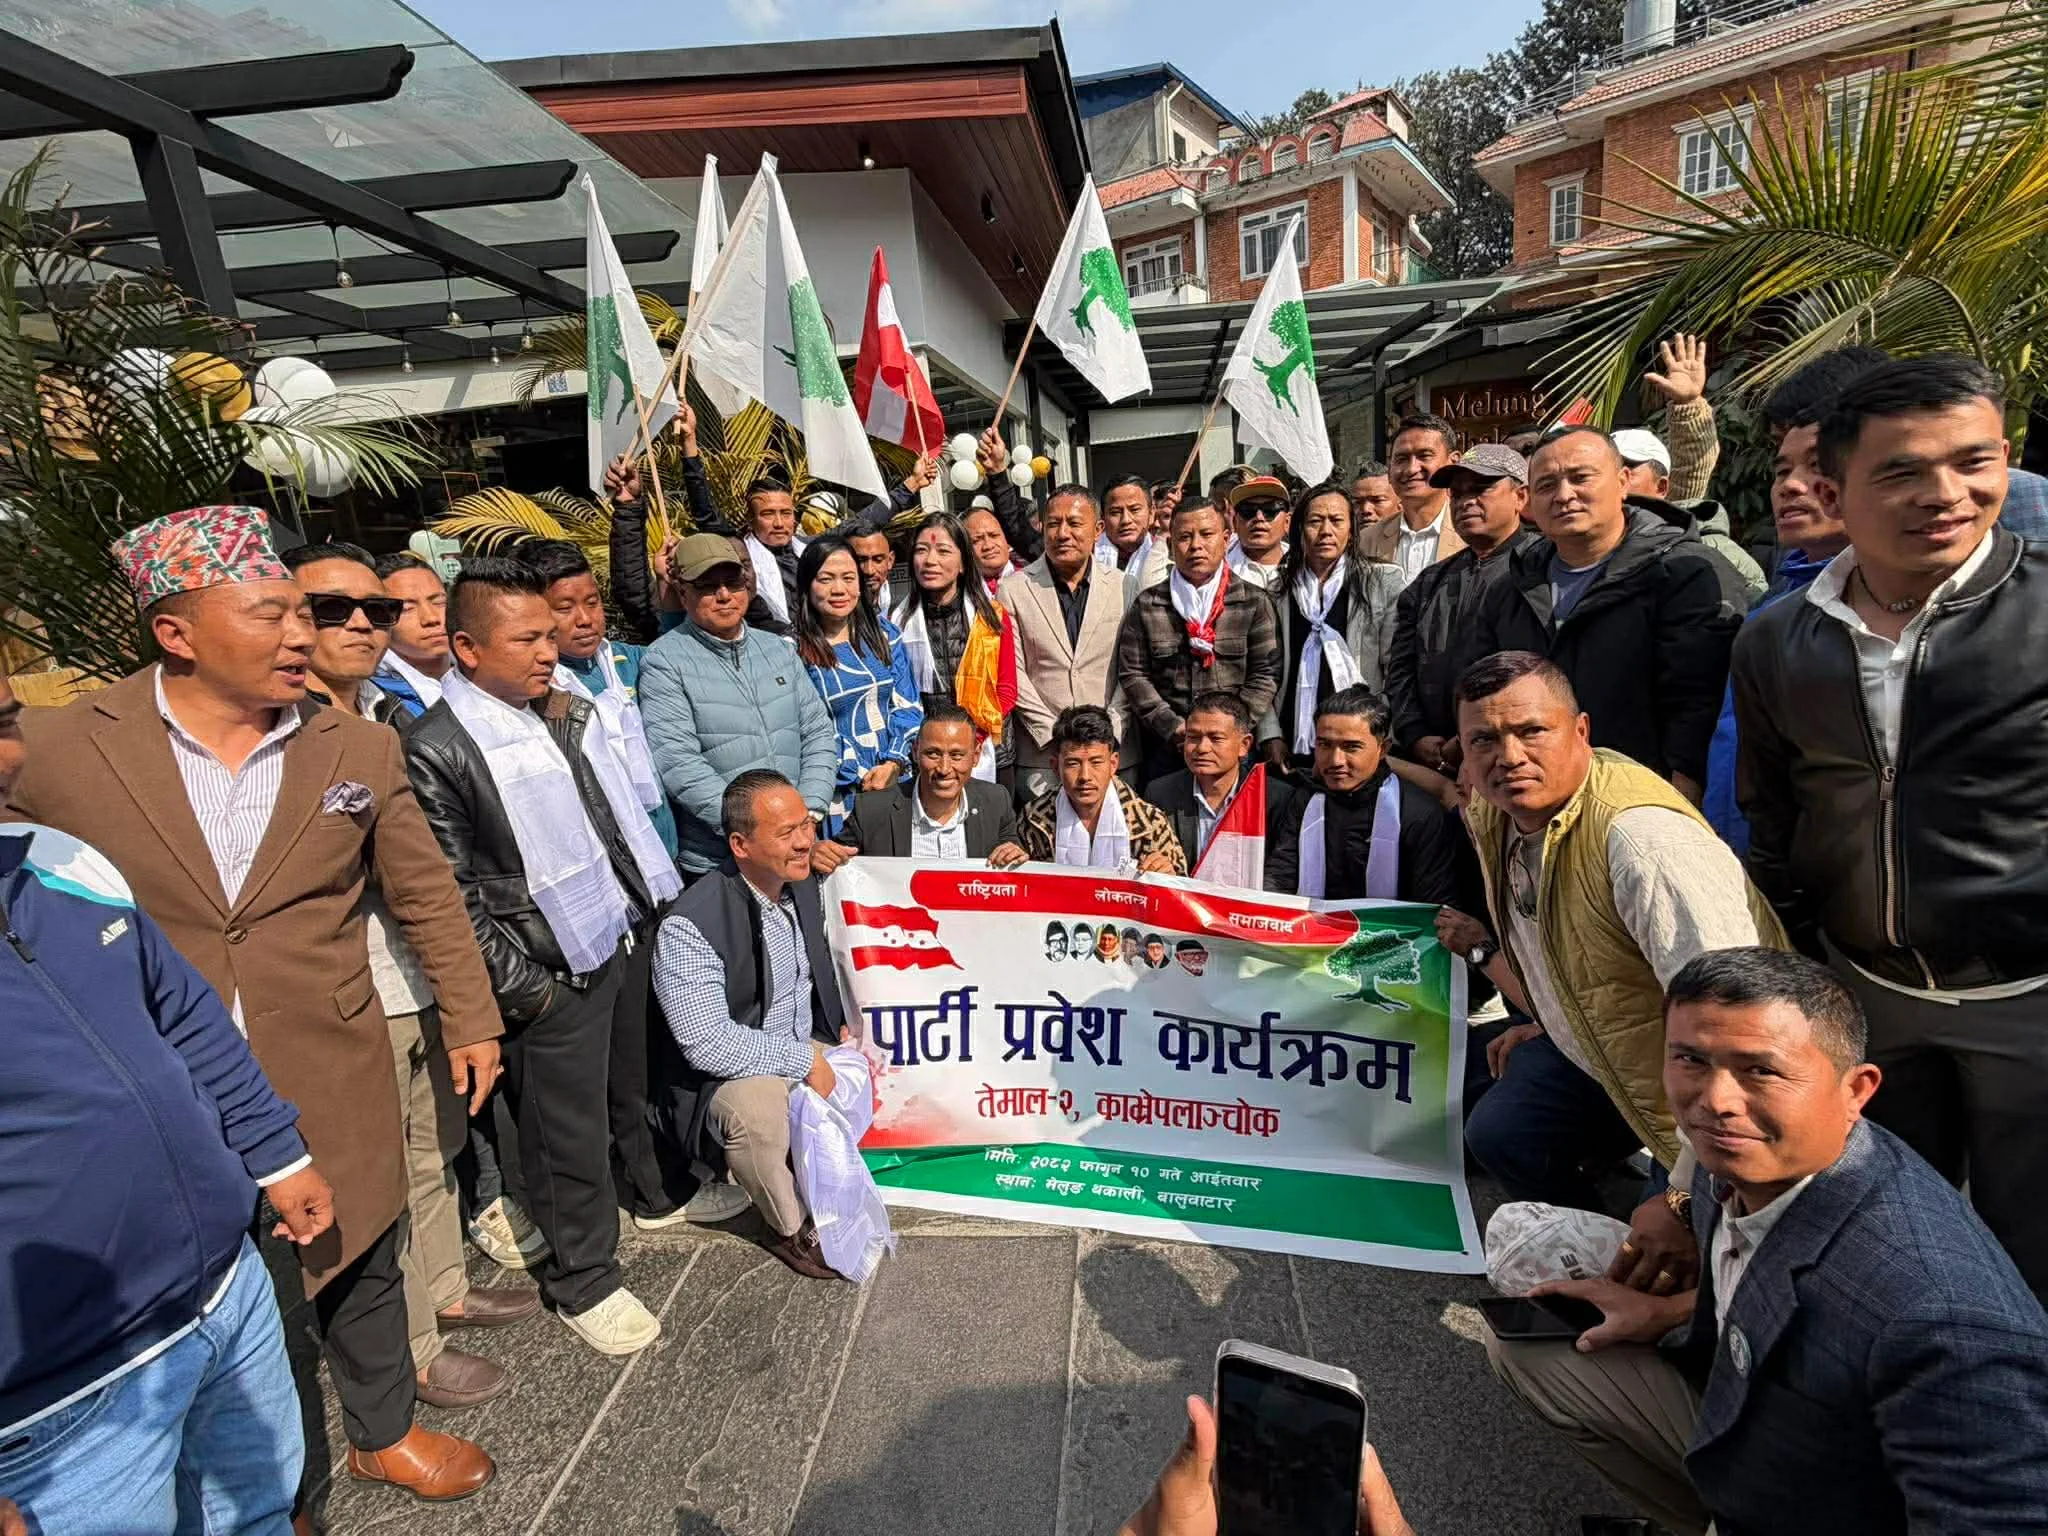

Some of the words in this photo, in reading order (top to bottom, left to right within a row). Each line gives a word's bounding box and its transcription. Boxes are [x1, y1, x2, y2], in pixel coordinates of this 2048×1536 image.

[1441, 389, 1546, 419] Melung
[1094, 888, 1148, 909] लोकतन्त्र
[1229, 911, 1294, 933] समाजवाद
[861, 986, 979, 1066] पार्टी
[994, 990, 1128, 1067] प्रवेश
[1153, 1011, 1416, 1104] कार्यक्रम
[1094, 1088, 1281, 1137] काभ्रेपलाञ्चोक
[1029, 1155, 1072, 1173] २०८२
[1080, 1160, 1124, 1177] फागुन
[1130, 1165, 1149, 1178] १०
[1159, 1167, 1184, 1181] गते
[1157, 1191, 1236, 1213] बालुवाटार
